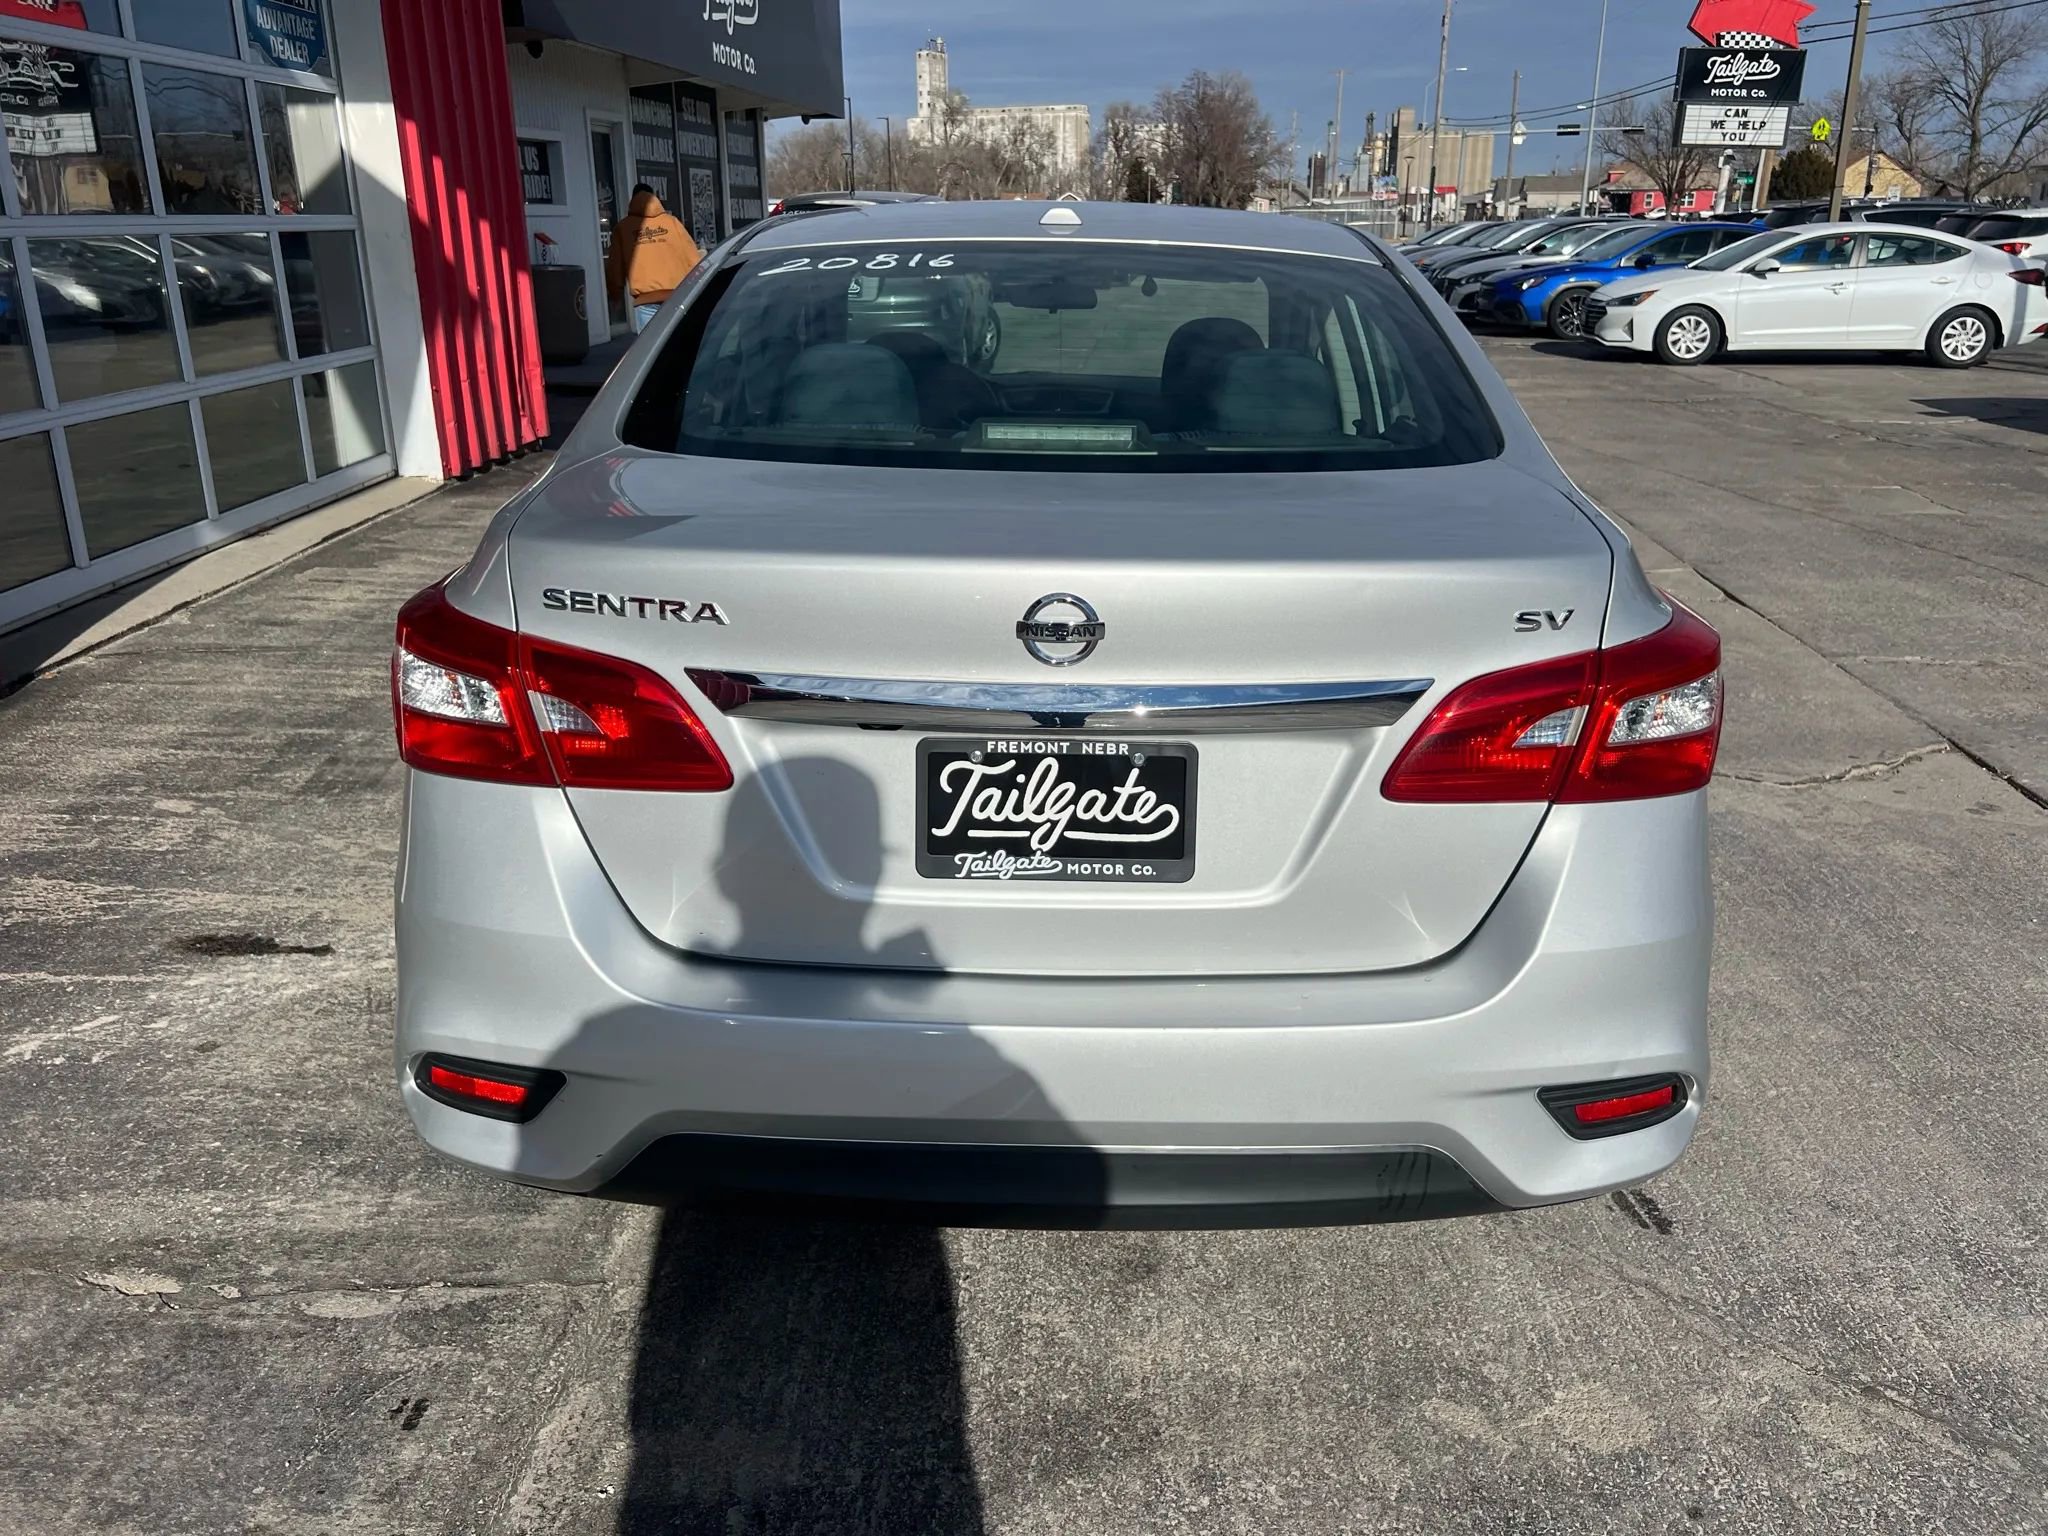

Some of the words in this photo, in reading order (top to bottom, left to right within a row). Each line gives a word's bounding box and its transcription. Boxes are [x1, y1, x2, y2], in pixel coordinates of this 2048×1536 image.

[256, 4, 316, 40] ADVANTAGE
[269, 35, 311, 65] DEALER
[712, 41, 742, 71] MOTOR
[1703, 52, 1781, 86] Tailgate
[1711, 88, 1748, 97] MOTOR
[1710, 119, 1727, 130] WE
[1738, 120, 1767, 131] HELP
[1724, 108, 1749, 118] CAN
[1721, 132, 1747, 142] YOU
[757, 252, 955, 277] 20816
[542, 587, 731, 626] SENTRA
[1024, 622, 1098, 638] NISSAN
[1513, 608, 1575, 633] SV
[986, 740, 1071, 754] FREMONT
[1081, 742, 1129, 755] NEBR
[931, 756, 1180, 852] Tailgate
[954, 849, 1063, 880] Tailgate
[1067, 863, 1125, 876] MOTOR
